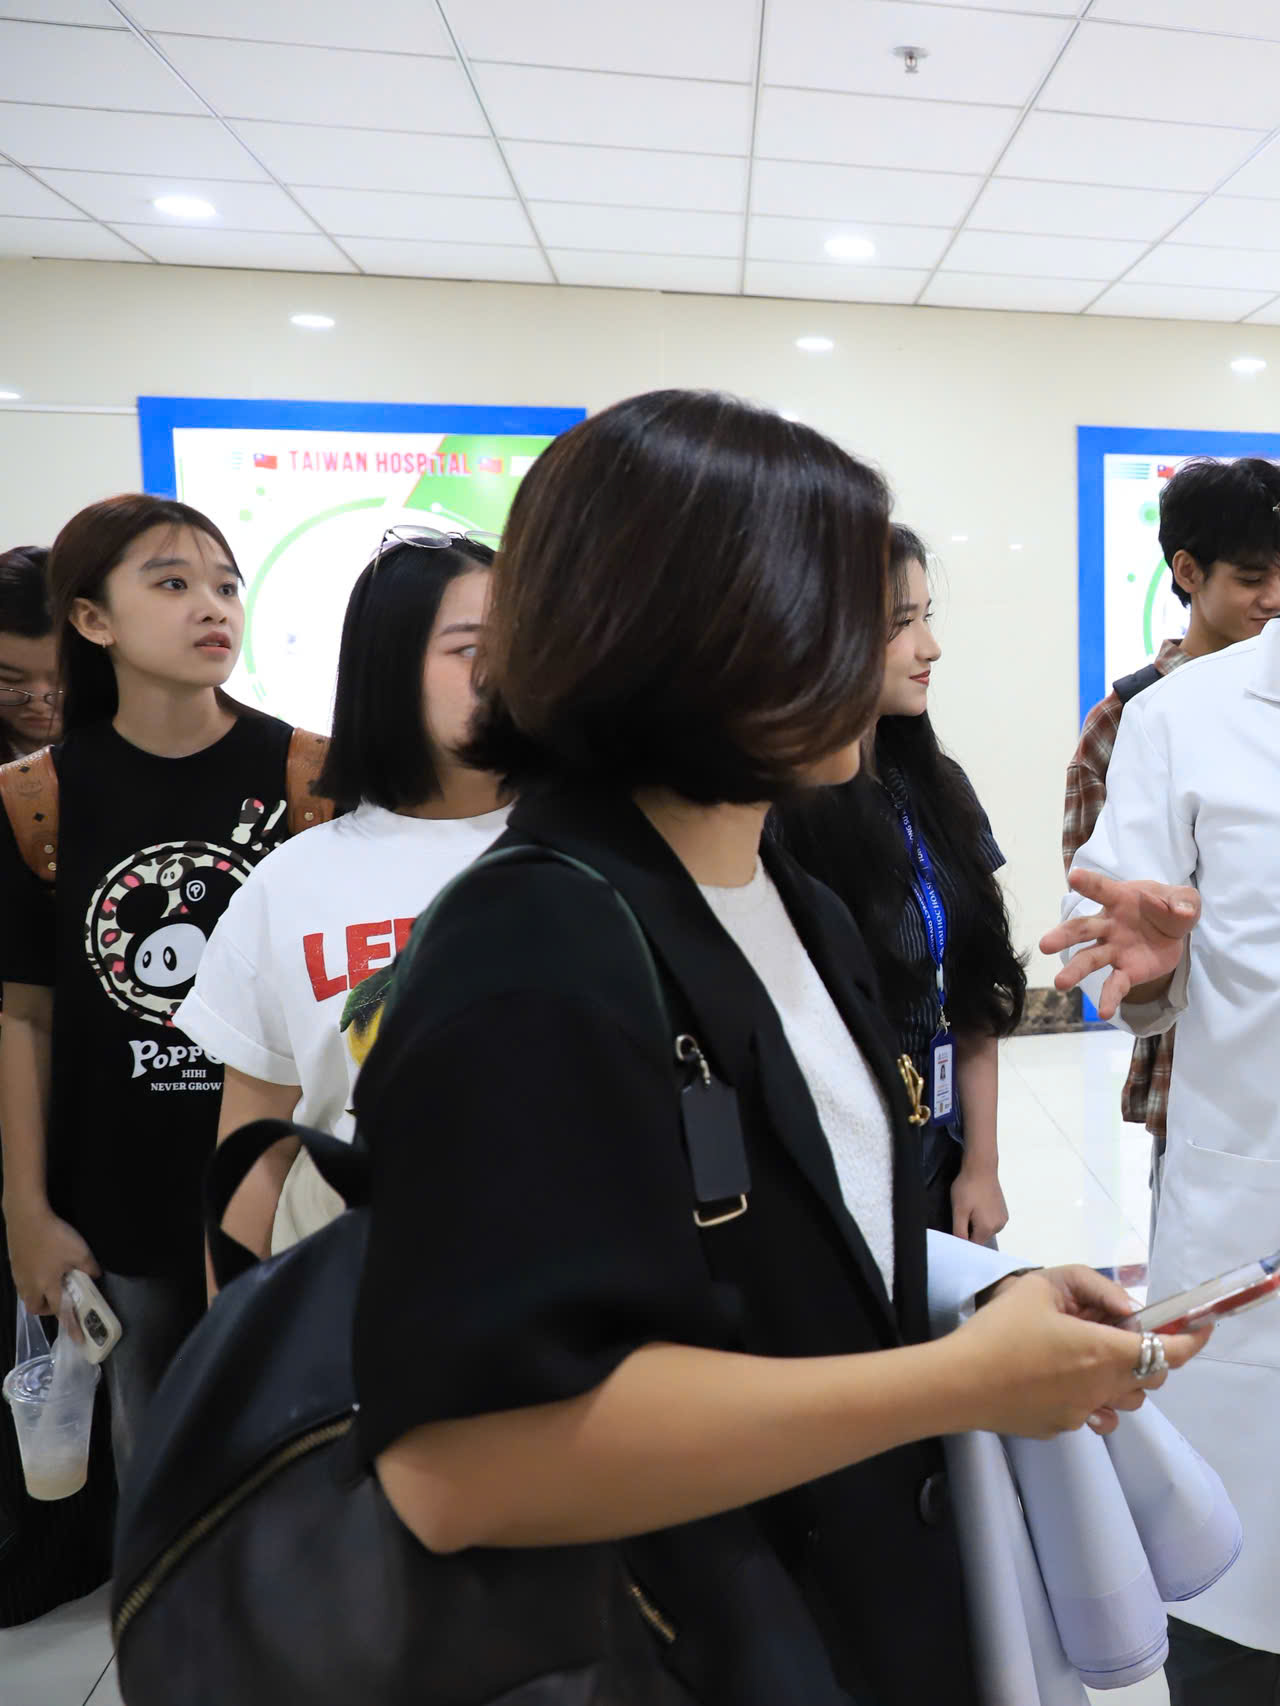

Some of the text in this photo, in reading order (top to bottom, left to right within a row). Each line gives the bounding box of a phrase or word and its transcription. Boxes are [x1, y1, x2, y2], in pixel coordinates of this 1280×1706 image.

[288, 450, 472, 474] TAIWAN HOSPITAL
[181, 1069, 207, 1078] HIHI
[150, 1082, 222, 1091] NEVER GROW
